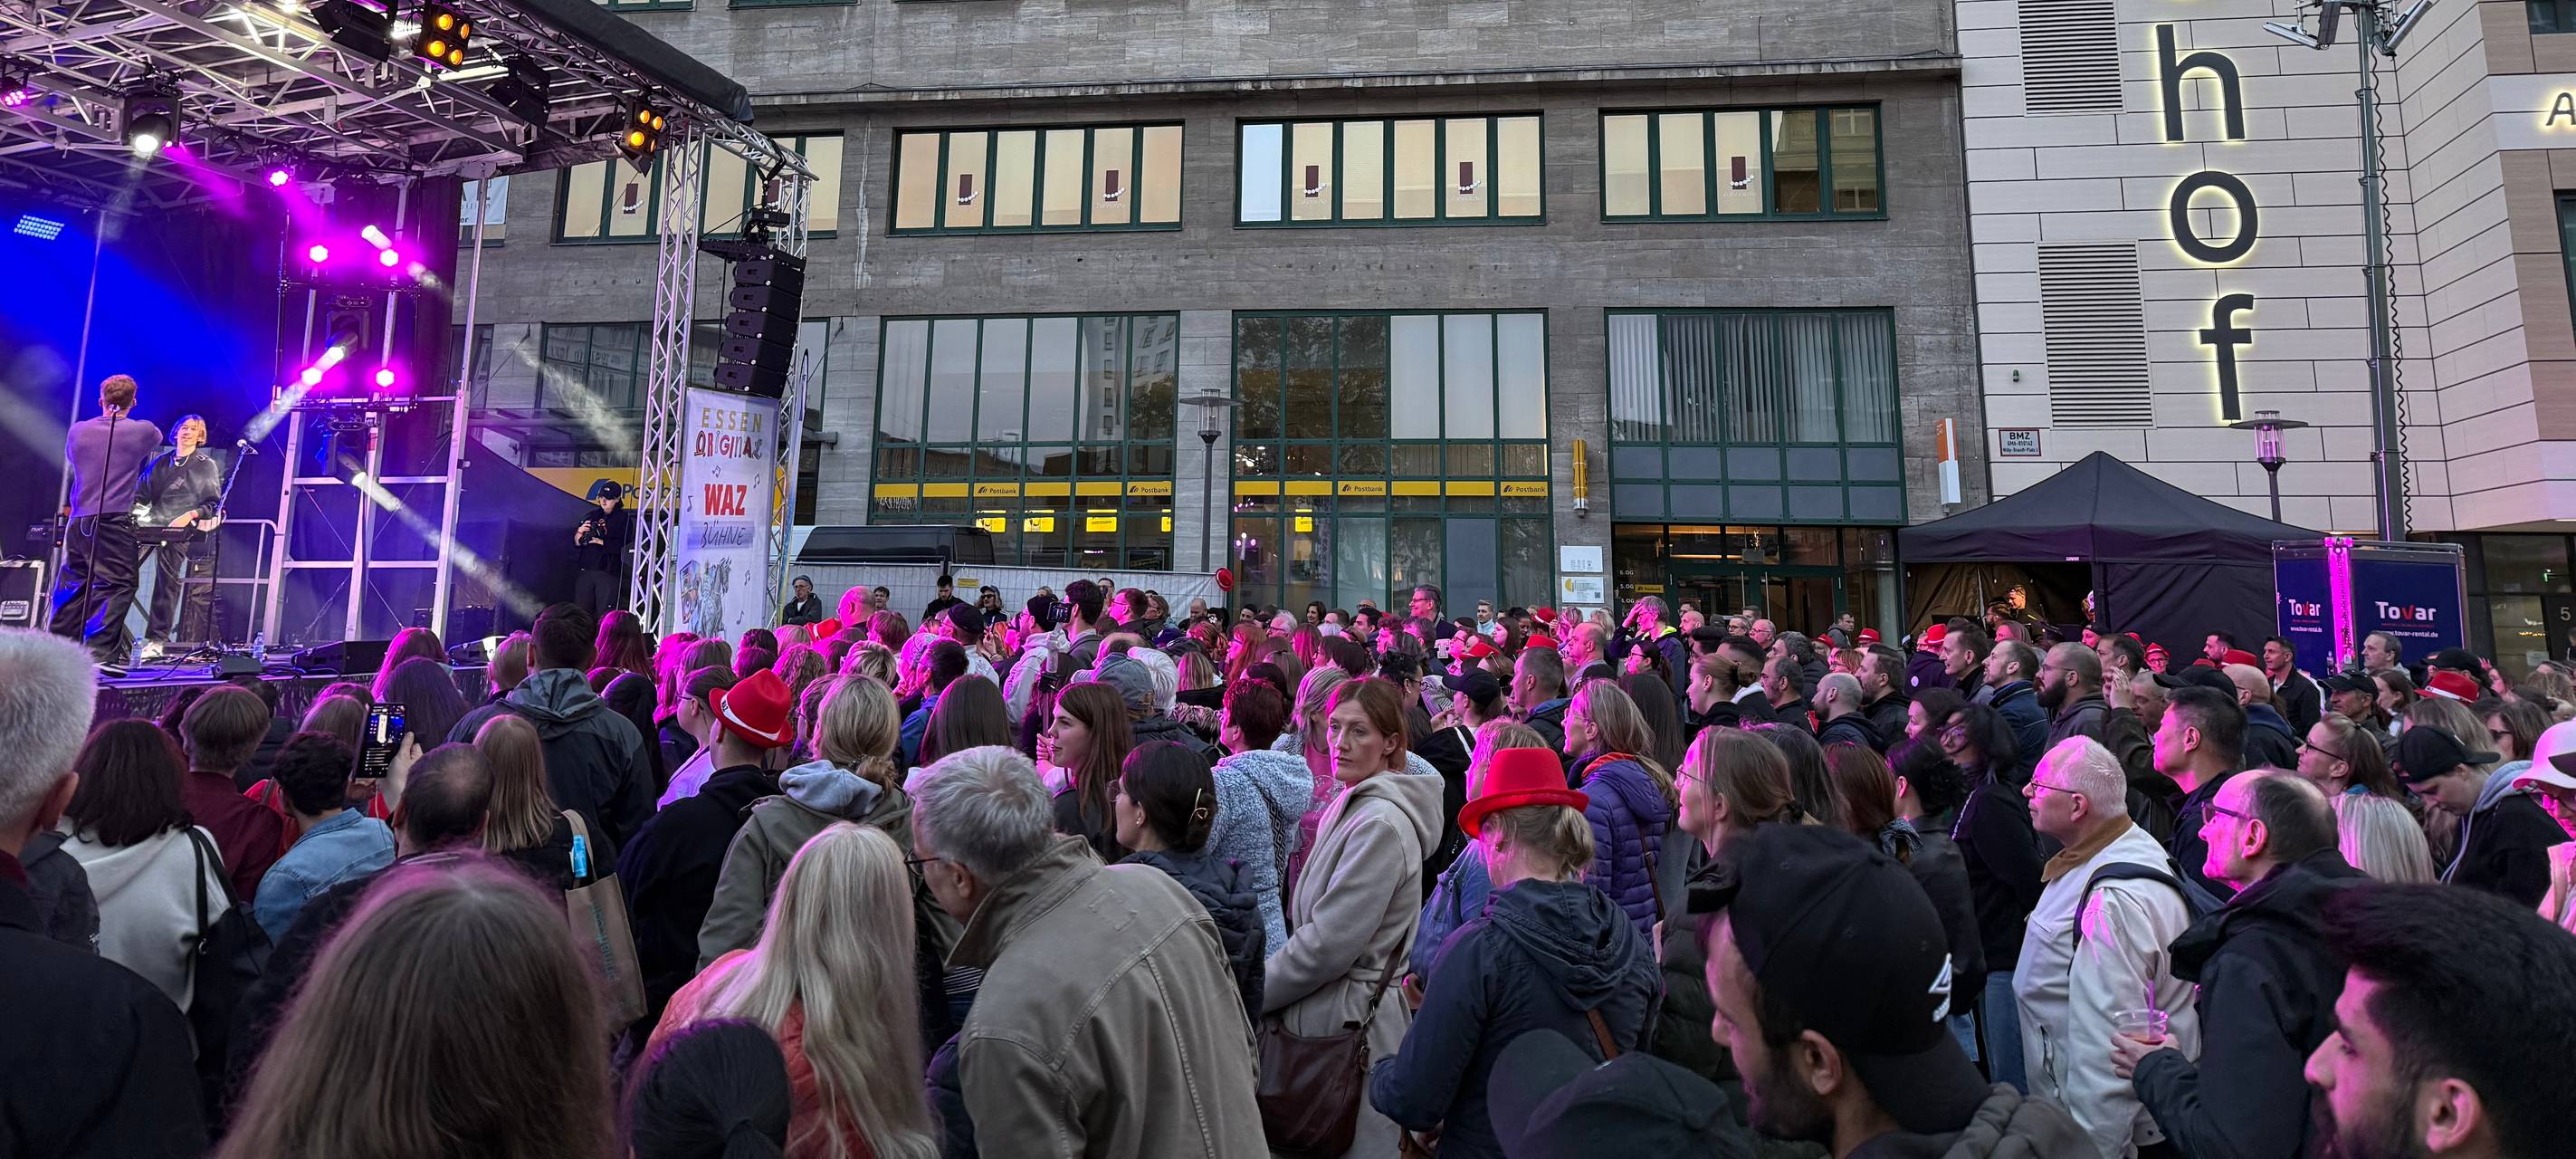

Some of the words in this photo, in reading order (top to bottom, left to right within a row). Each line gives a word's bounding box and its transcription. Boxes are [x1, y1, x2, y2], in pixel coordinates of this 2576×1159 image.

[701, 407, 762, 433] ESSEN
[2009, 432, 2031, 440] BMZ
[704, 483, 748, 515] WAZ
[2288, 599, 2321, 617] Tovar
[2375, 600, 2437, 621] Tovar
[2560, 607, 2571, 621] 5
